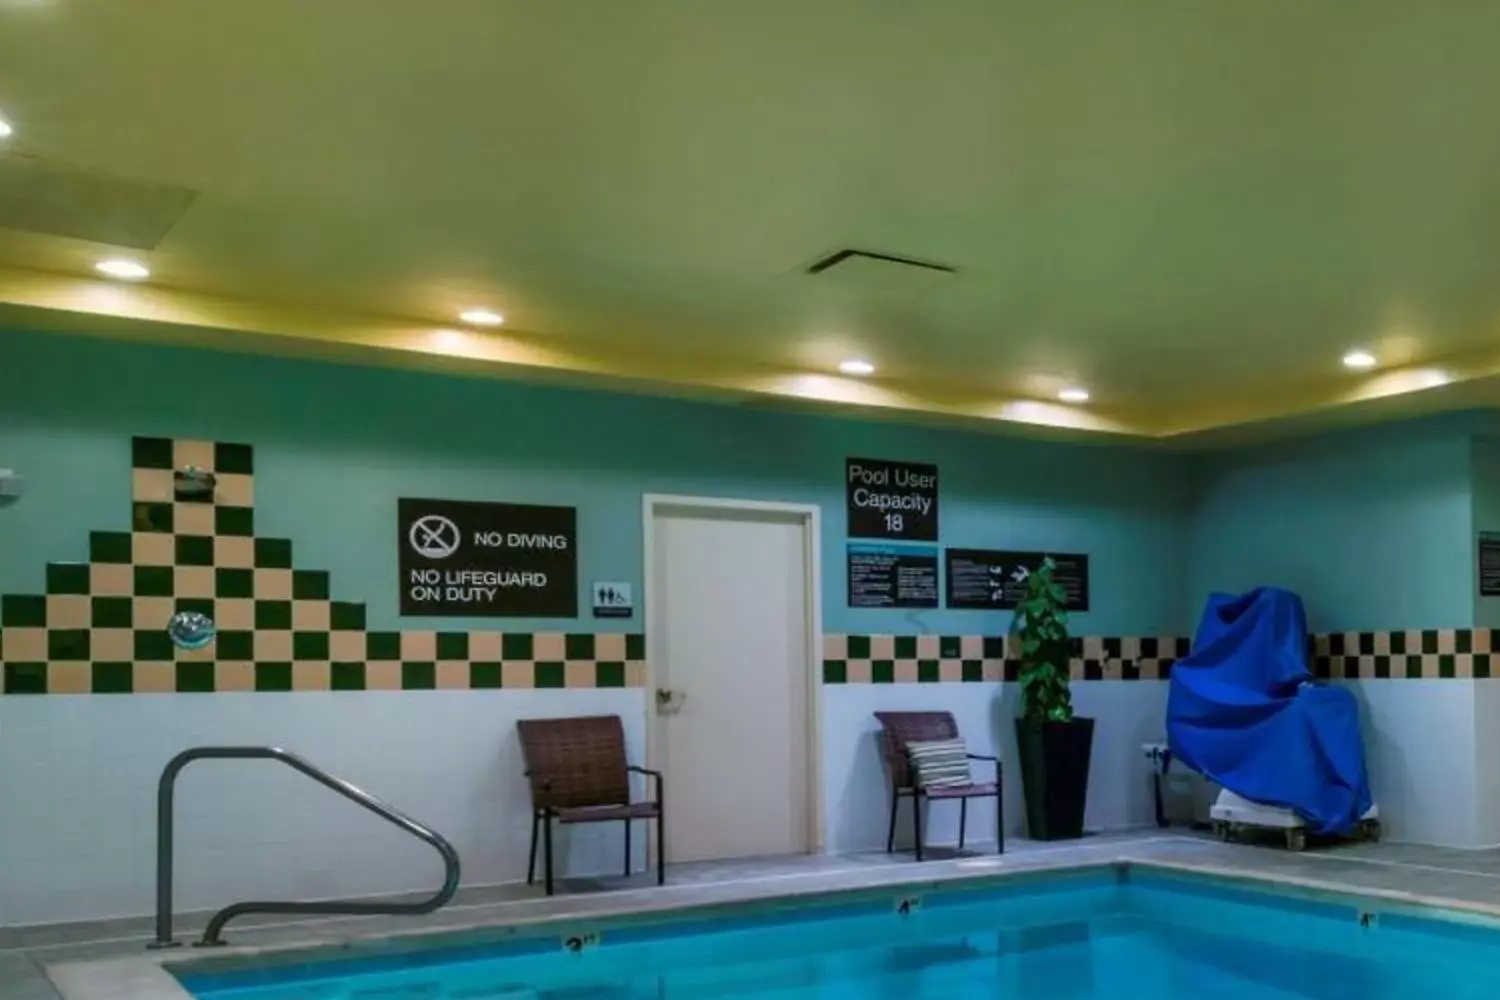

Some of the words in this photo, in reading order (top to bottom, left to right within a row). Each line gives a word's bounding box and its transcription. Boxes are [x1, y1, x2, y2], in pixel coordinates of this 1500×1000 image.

[848, 464, 889, 486] Pool
[894, 469, 937, 489] User
[853, 488, 932, 515] Capacity
[883, 513, 904, 532] 18
[474, 531, 503, 547] NO
[507, 533, 567, 550] DIVING
[411, 569, 440, 585] NO
[445, 570, 547, 587] LIFEGUARD
[411, 586, 440, 601] ON
[446, 587, 497, 602] DUTY
